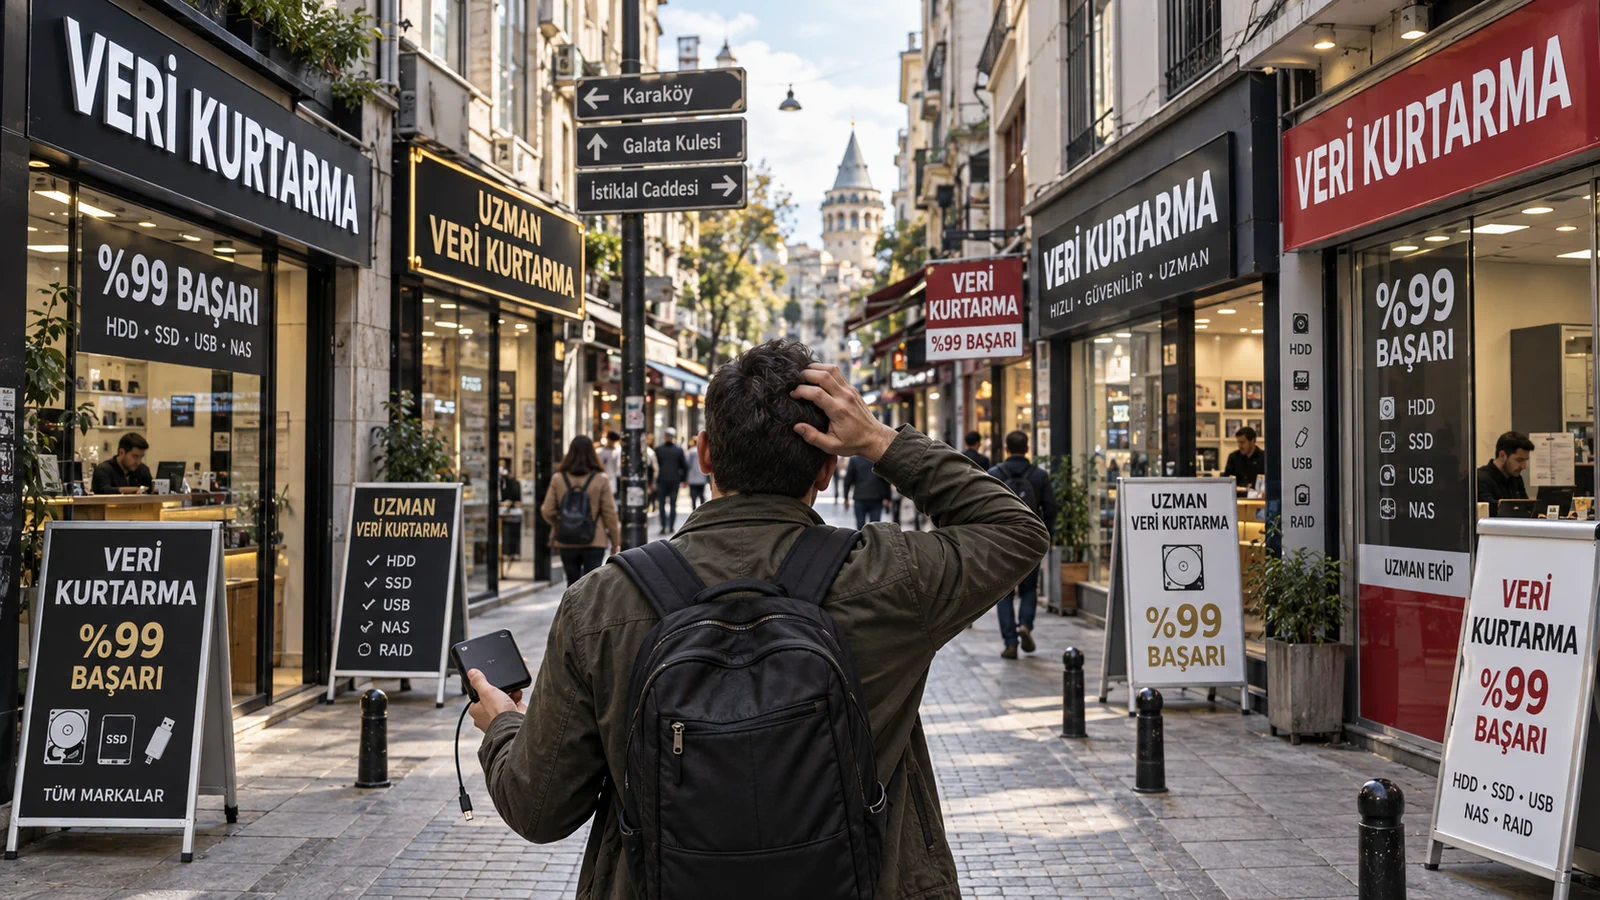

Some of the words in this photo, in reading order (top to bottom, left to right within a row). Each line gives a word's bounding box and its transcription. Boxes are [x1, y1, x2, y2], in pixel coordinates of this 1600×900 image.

[623, 85, 693, 105] Karaköy
[63, 16, 177, 154] VERİ
[190, 88, 359, 234] KURTARMA
[1295, 117, 1354, 210] VERİ
[1363, 34, 1572, 186] KURTARMA
[623, 137, 671, 154] Galata
[676, 132, 721, 151] Kulesi
[591, 179, 638, 200] İstiklal
[642, 178, 698, 197] Caddesi
[478, 190, 541, 246] UZMAN
[1043, 225, 1080, 290] VERİ
[1086, 169, 1218, 274] KURTARMA
[429, 214, 480, 267] VERİ
[486, 235, 575, 299] KURTARMA
[98, 244, 168, 306] %99
[177, 266, 259, 328] BAŞARI
[952, 265, 993, 293] VERİ
[1050, 297, 1073, 318] HIZLI
[1085, 272, 1143, 306] GÜVENİLİR
[1159, 247, 1209, 280] UZMAN
[930, 295, 1018, 320] KURTARMA
[1376, 268, 1455, 330] %99
[106, 316, 138, 339] HDD
[155, 325, 179, 346] SSD
[194, 333, 217, 352] USB
[230, 339, 251, 358] NAS
[931, 334, 961, 352] %99
[967, 331, 1016, 353] BAŞARI
[1289, 343, 1312, 355] HDD
[1376, 328, 1454, 372] BAŞARI
[1291, 400, 1311, 412] SSD
[1408, 398, 1435, 416] HDD
[1408, 433, 1433, 450] SSD
[1292, 458, 1312, 470] USB
[1408, 467, 1434, 485] USB
[373, 497, 435, 516] UZMAN
[1151, 493, 1207, 509] UZMAN
[1409, 501, 1435, 519] NAS
[356, 518, 383, 538] VERİ
[385, 522, 448, 538] KURTARMA
[1131, 512, 1159, 530] VERİ
[1162, 515, 1229, 530] KURTARMA
[1290, 516, 1314, 528] RAID
[104, 540, 162, 572] VERİ
[386, 554, 416, 567] HDD
[1384, 558, 1424, 580] UZMAN
[1428, 560, 1453, 582] EKİP
[54, 580, 197, 606] KURTARMA
[385, 576, 412, 589] SSD
[1502, 573, 1552, 611] VERİ
[383, 599, 410, 612] USB
[381, 621, 410, 634] NAS
[1146, 603, 1222, 638] %99
[79, 621, 164, 659] %99
[1471, 616, 1578, 655] KURTARMA
[379, 643, 413, 656] RAID
[1147, 645, 1225, 672] BAŞARI
[71, 665, 164, 696] BAŞARI
[1480, 666, 1549, 715] %99
[106, 734, 128, 745] SSD
[1474, 715, 1547, 755] BAŞARI
[43, 785, 76, 802] TÜM
[80, 788, 164, 803] MARKALAR
[1452, 771, 1478, 793] HDD
[1491, 781, 1515, 803] SSD
[1528, 791, 1554, 813] USB
[1464, 802, 1489, 825] NAS
[1502, 813, 1533, 837] RAID
